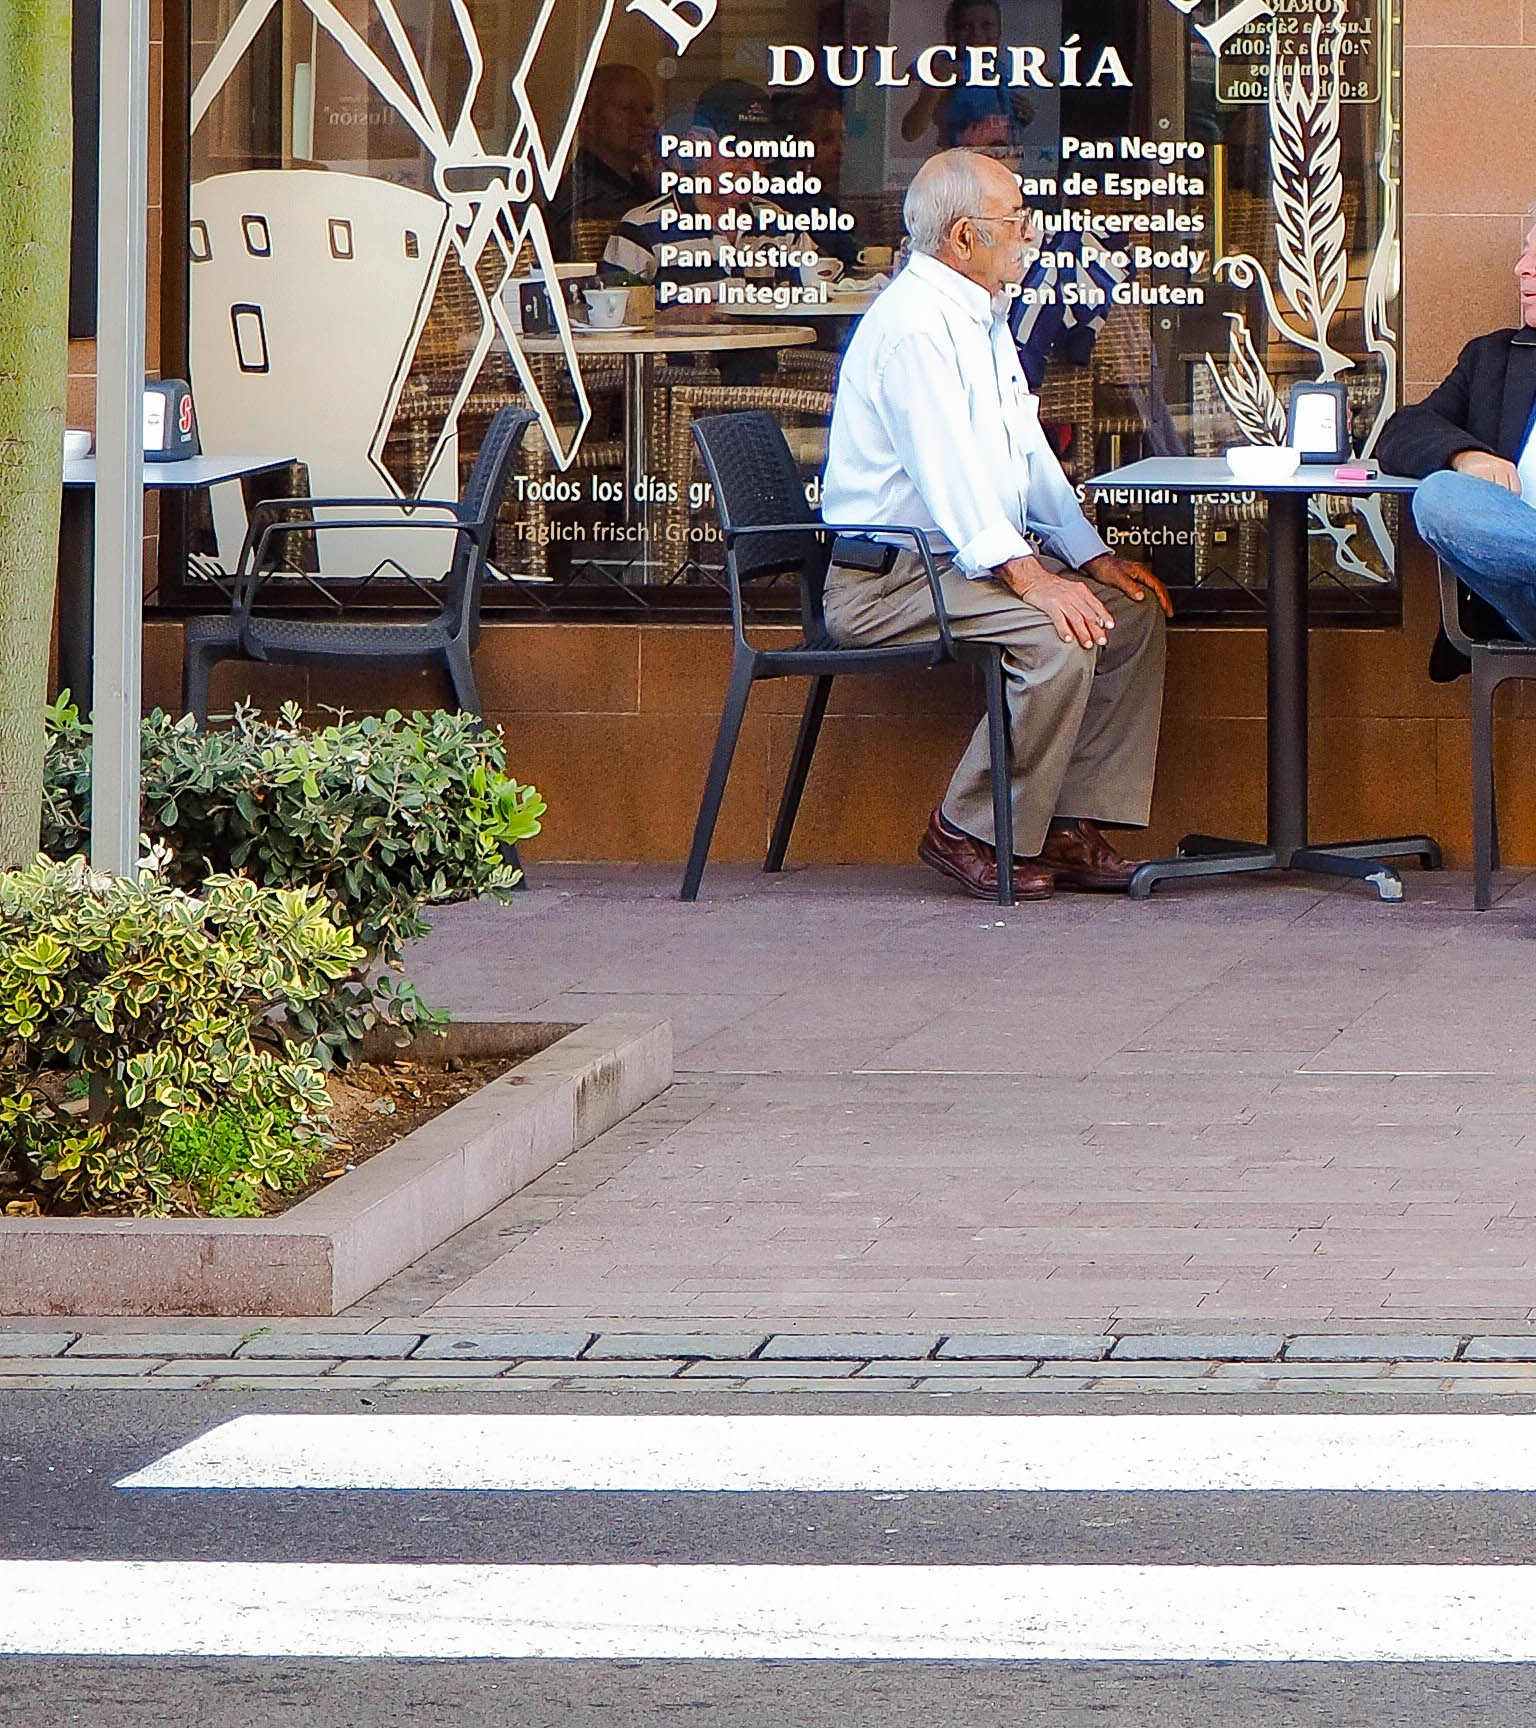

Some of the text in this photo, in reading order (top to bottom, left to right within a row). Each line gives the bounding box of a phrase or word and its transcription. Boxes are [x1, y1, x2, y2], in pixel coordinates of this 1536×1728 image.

[767, 32, 1134, 89] DULCERÍA
[660, 134, 815, 159] Pan Común
[1061, 136, 1205, 165] Pan Negro
[660, 171, 822, 196] Pan Sobado
[1062, 172, 1099, 196] de
[1103, 172, 1205, 201] Espelta
[660, 208, 855, 232] Pan de Pueblo
[660, 244, 819, 269] Pan Rústico
[1023, 246, 1205, 274] Pan Pro Body
[660, 281, 828, 310] Pan Integral
[1005, 281, 1205, 306] Pan Sin Gluten
[513, 474, 581, 502] Todos
[591, 474, 623, 502] los
[633, 474, 679, 502] días
[592, 520, 658, 542] frisch!
[1106, 525, 1202, 546] Brötchen
